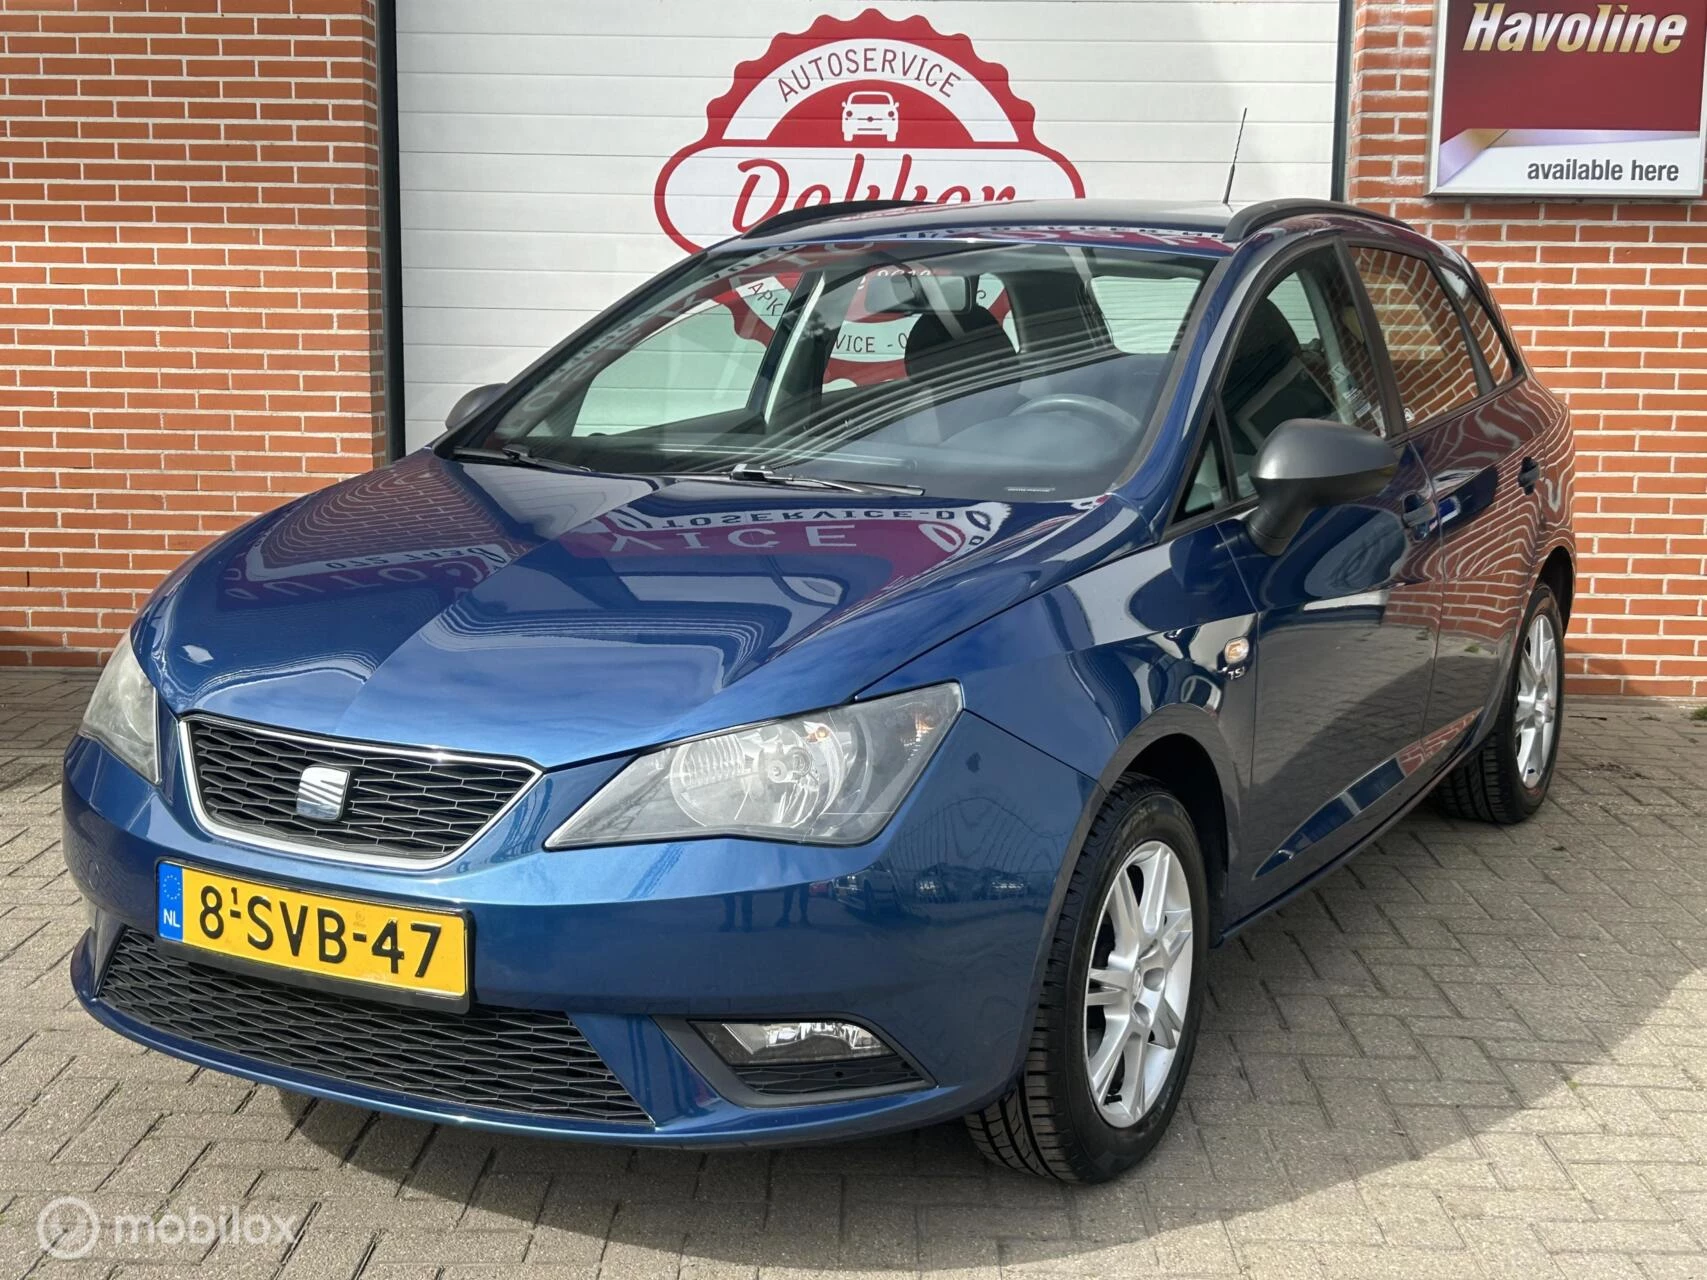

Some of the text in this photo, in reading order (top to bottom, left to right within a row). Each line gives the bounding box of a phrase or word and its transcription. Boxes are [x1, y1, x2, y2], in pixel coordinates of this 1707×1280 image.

[1463, 2, 1688, 54] Havoline
[777, 47, 961, 103] AUTOSERVICE
[1527, 158, 1679, 182] available here
[163, 908, 181, 928] NL
